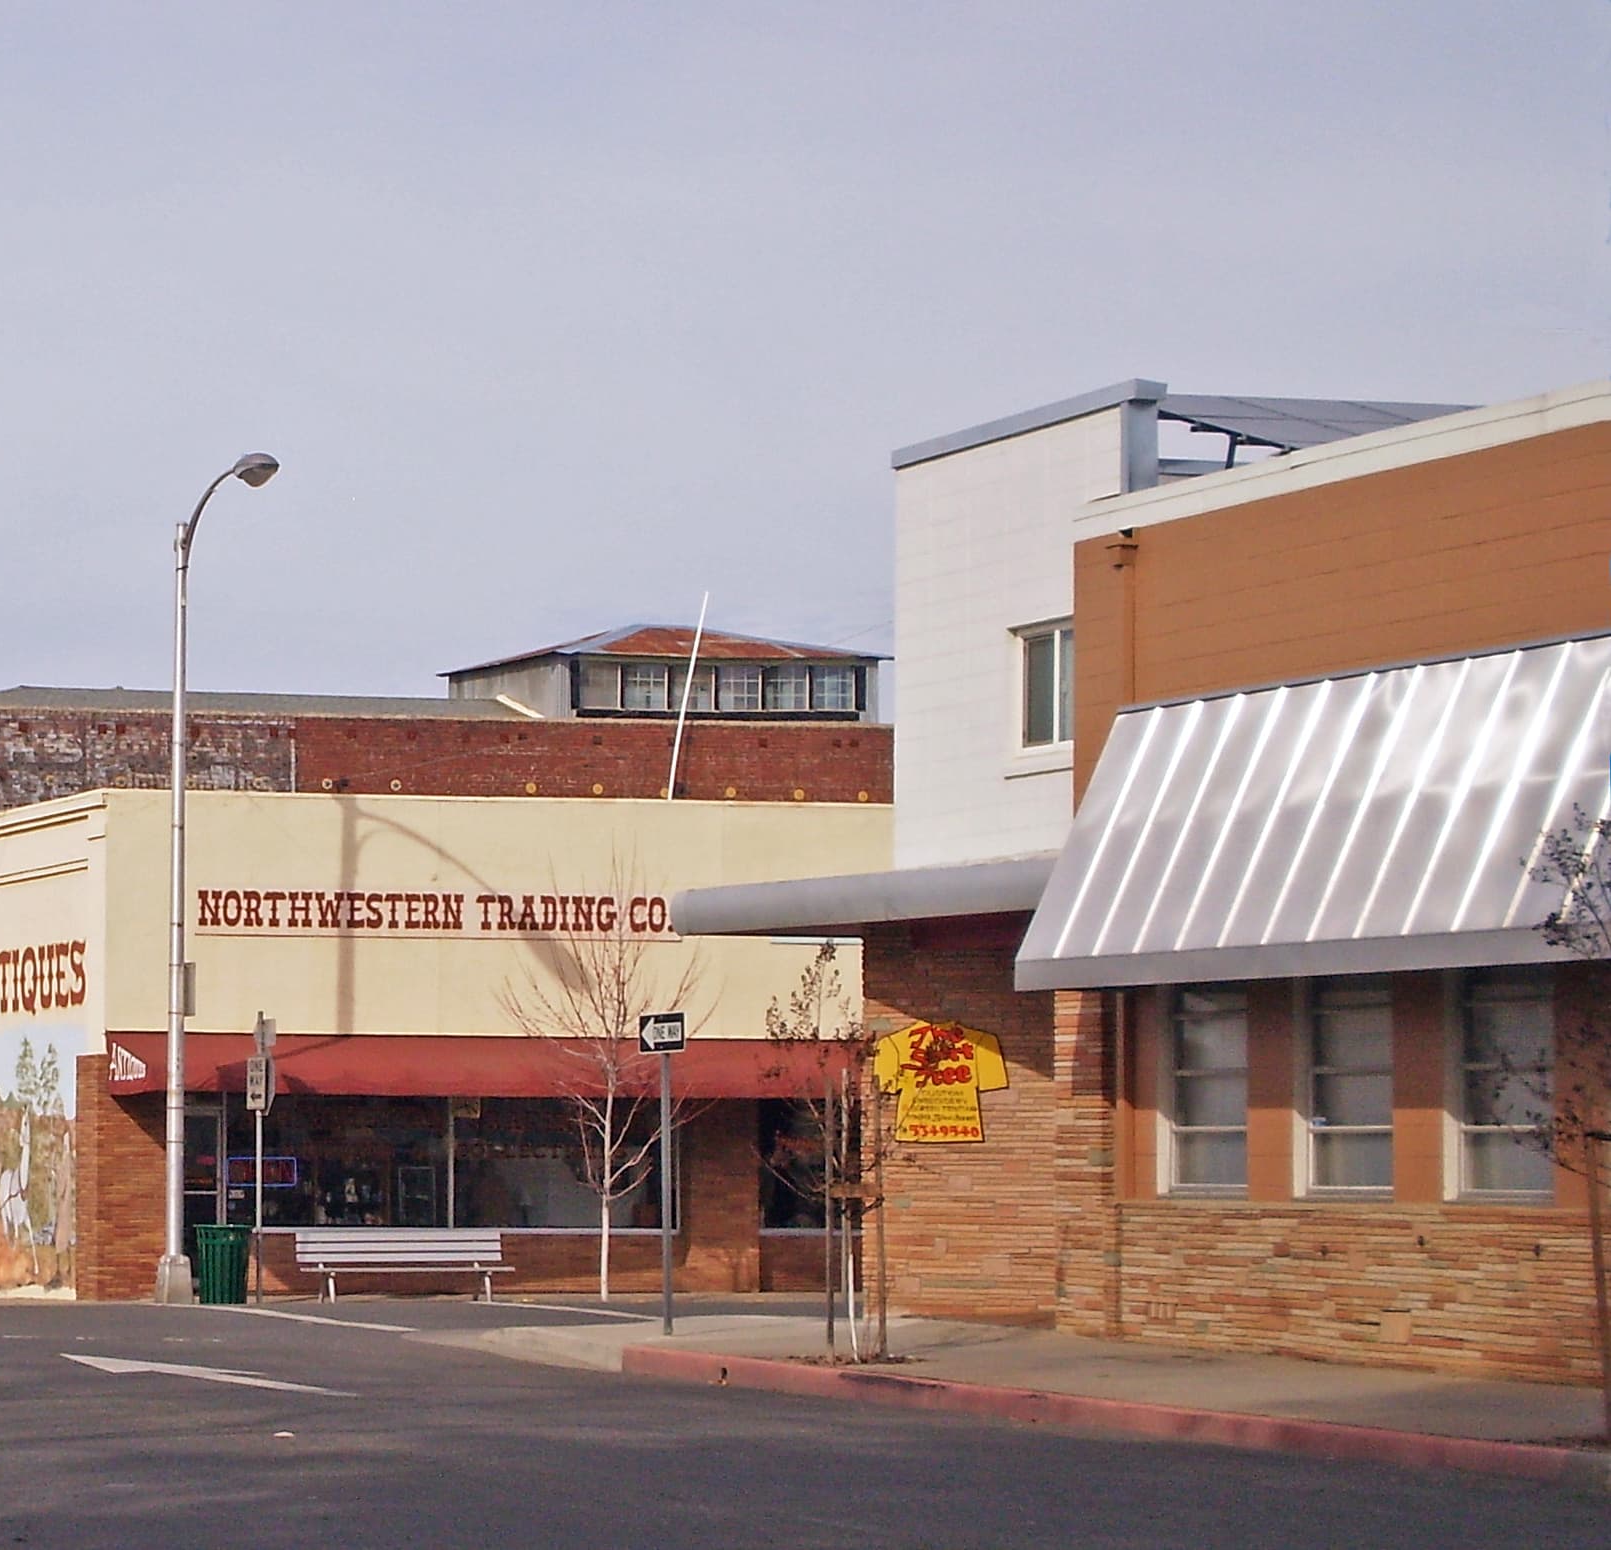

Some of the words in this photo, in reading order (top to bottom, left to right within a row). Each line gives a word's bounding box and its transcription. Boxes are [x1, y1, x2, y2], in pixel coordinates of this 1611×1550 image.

[198, 890, 465, 930] NORTHWESTERN
[476, 895, 617, 932] TRADING
[628, 896, 674, 933] CO.
[652, 1024, 666, 1040] ONE
[667, 1023, 680, 1039] WAY
[249, 1060, 264, 1073] ONE
